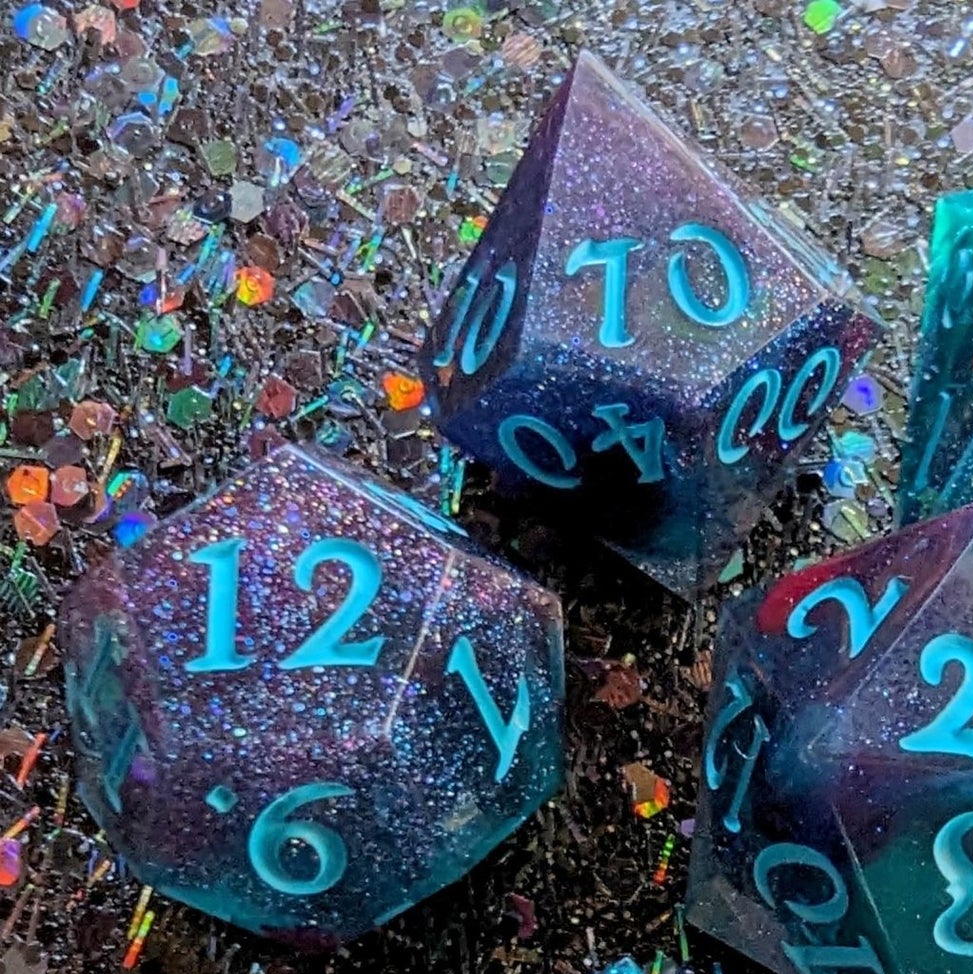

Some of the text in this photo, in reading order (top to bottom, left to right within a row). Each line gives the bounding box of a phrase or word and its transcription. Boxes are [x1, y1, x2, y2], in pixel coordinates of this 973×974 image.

[565, 221, 750, 348] 70
[718, 347, 841, 465] 00
[184, 537, 387, 673] 12
[787, 575, 911, 658] 2
